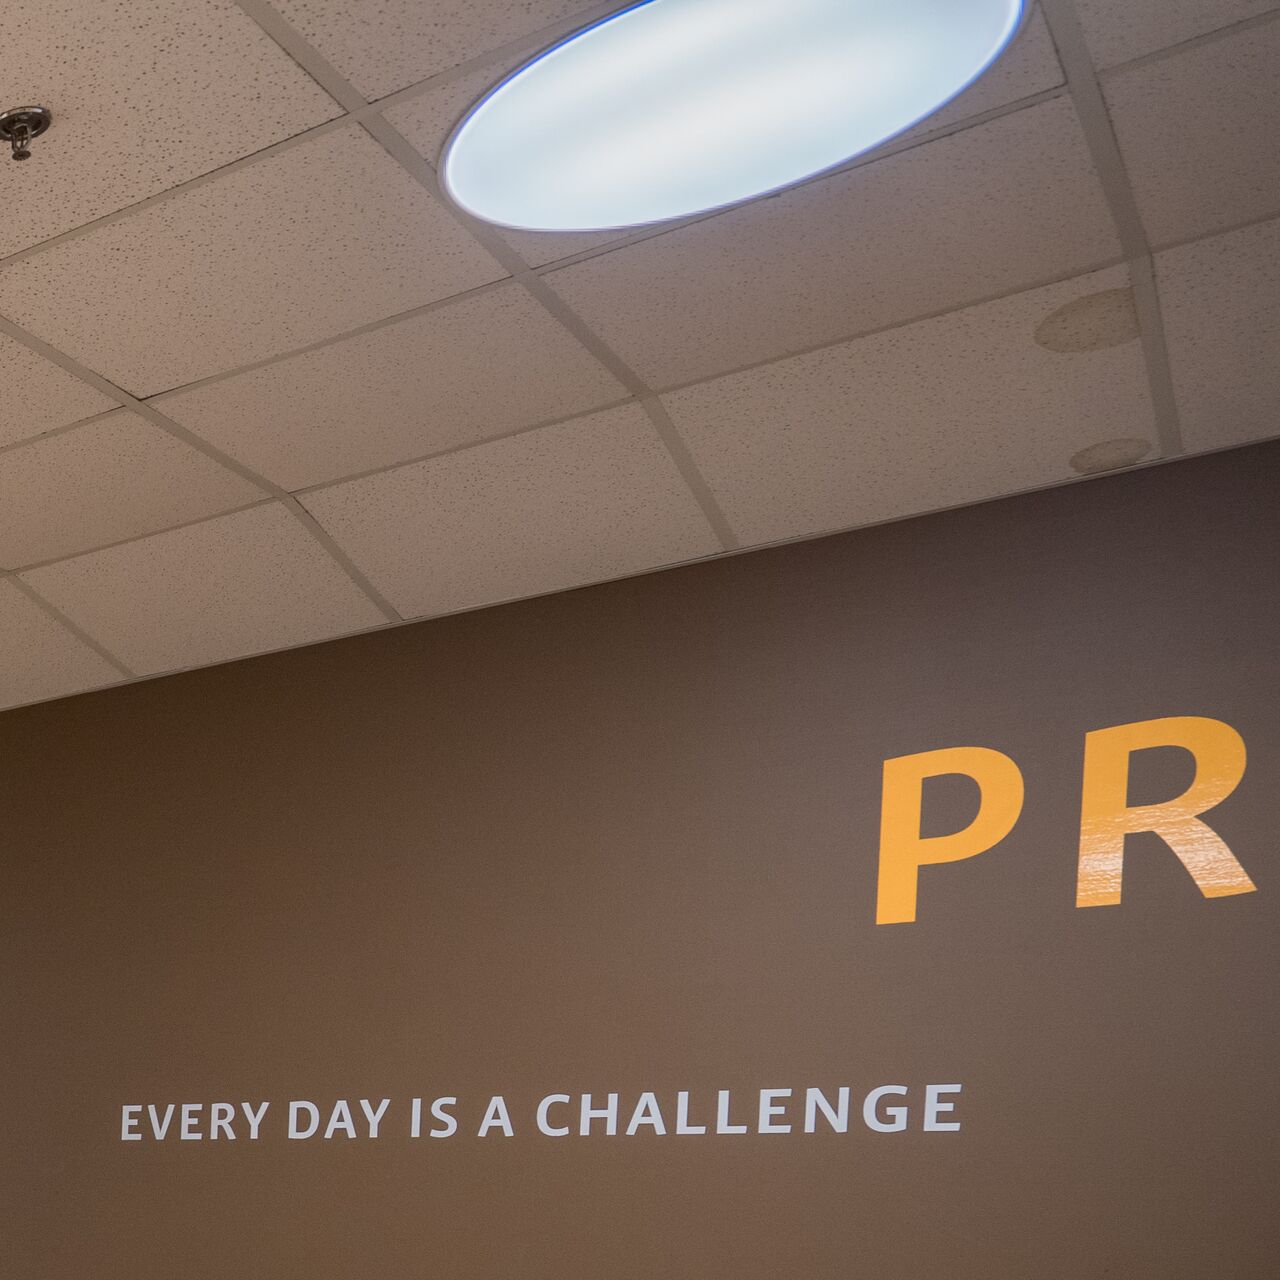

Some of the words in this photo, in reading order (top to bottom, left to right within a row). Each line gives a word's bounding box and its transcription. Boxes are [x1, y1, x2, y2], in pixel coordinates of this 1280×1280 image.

[121, 1102, 270, 1141] EVERY
[287, 1099, 391, 1140] DAY
[411, 1096, 458, 1138] IS
[477, 1096, 515, 1138] A
[536, 1084, 963, 1137] CHALLENGE
